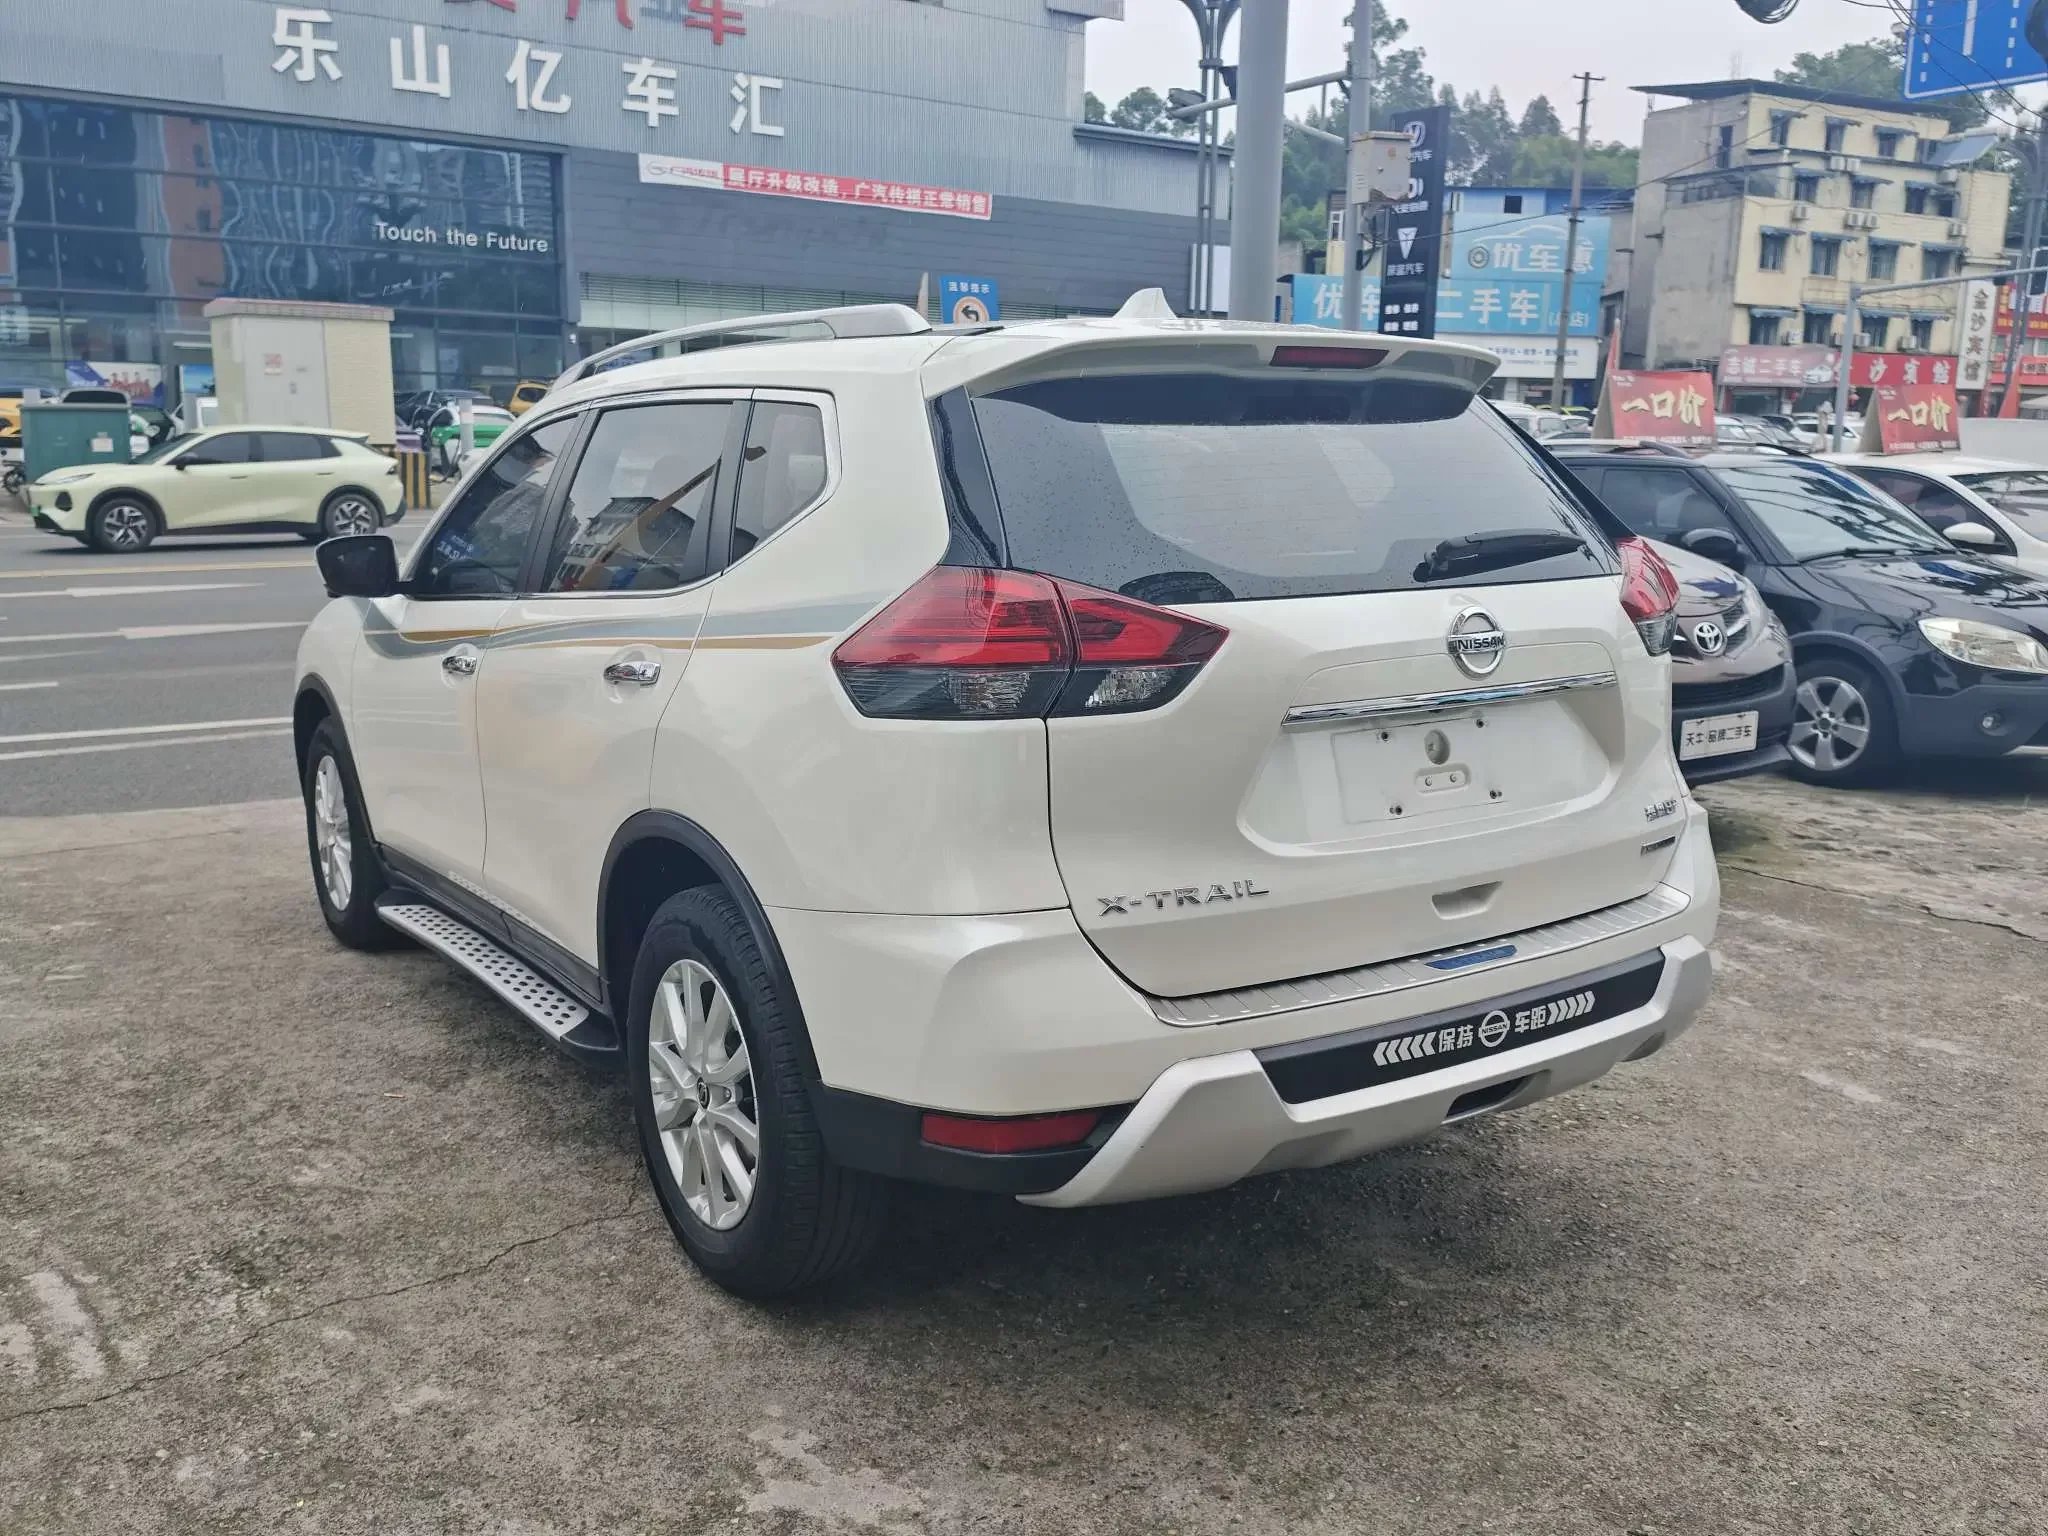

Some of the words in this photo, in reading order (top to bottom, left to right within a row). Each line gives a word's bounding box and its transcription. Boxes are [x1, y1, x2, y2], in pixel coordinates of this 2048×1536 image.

[272, 8, 785, 137] 乐山亿车汇
[375, 221, 437, 243] Touch
[446, 229, 478, 246] the
[486, 232, 549, 252] Future
[1313, 284, 1540, 326] 优车二手车
[1621, 384, 1707, 428] 一口价
[1887, 393, 1952, 433] 一口价
[1458, 635, 1504, 650] NISSAN
[1097, 879, 1270, 917] X-TRAIL
[1438, 1024, 1474, 1053] 保持
[1481, 1022, 1509, 1036] NISSAN
[1515, 1005, 1547, 1034] 车距
